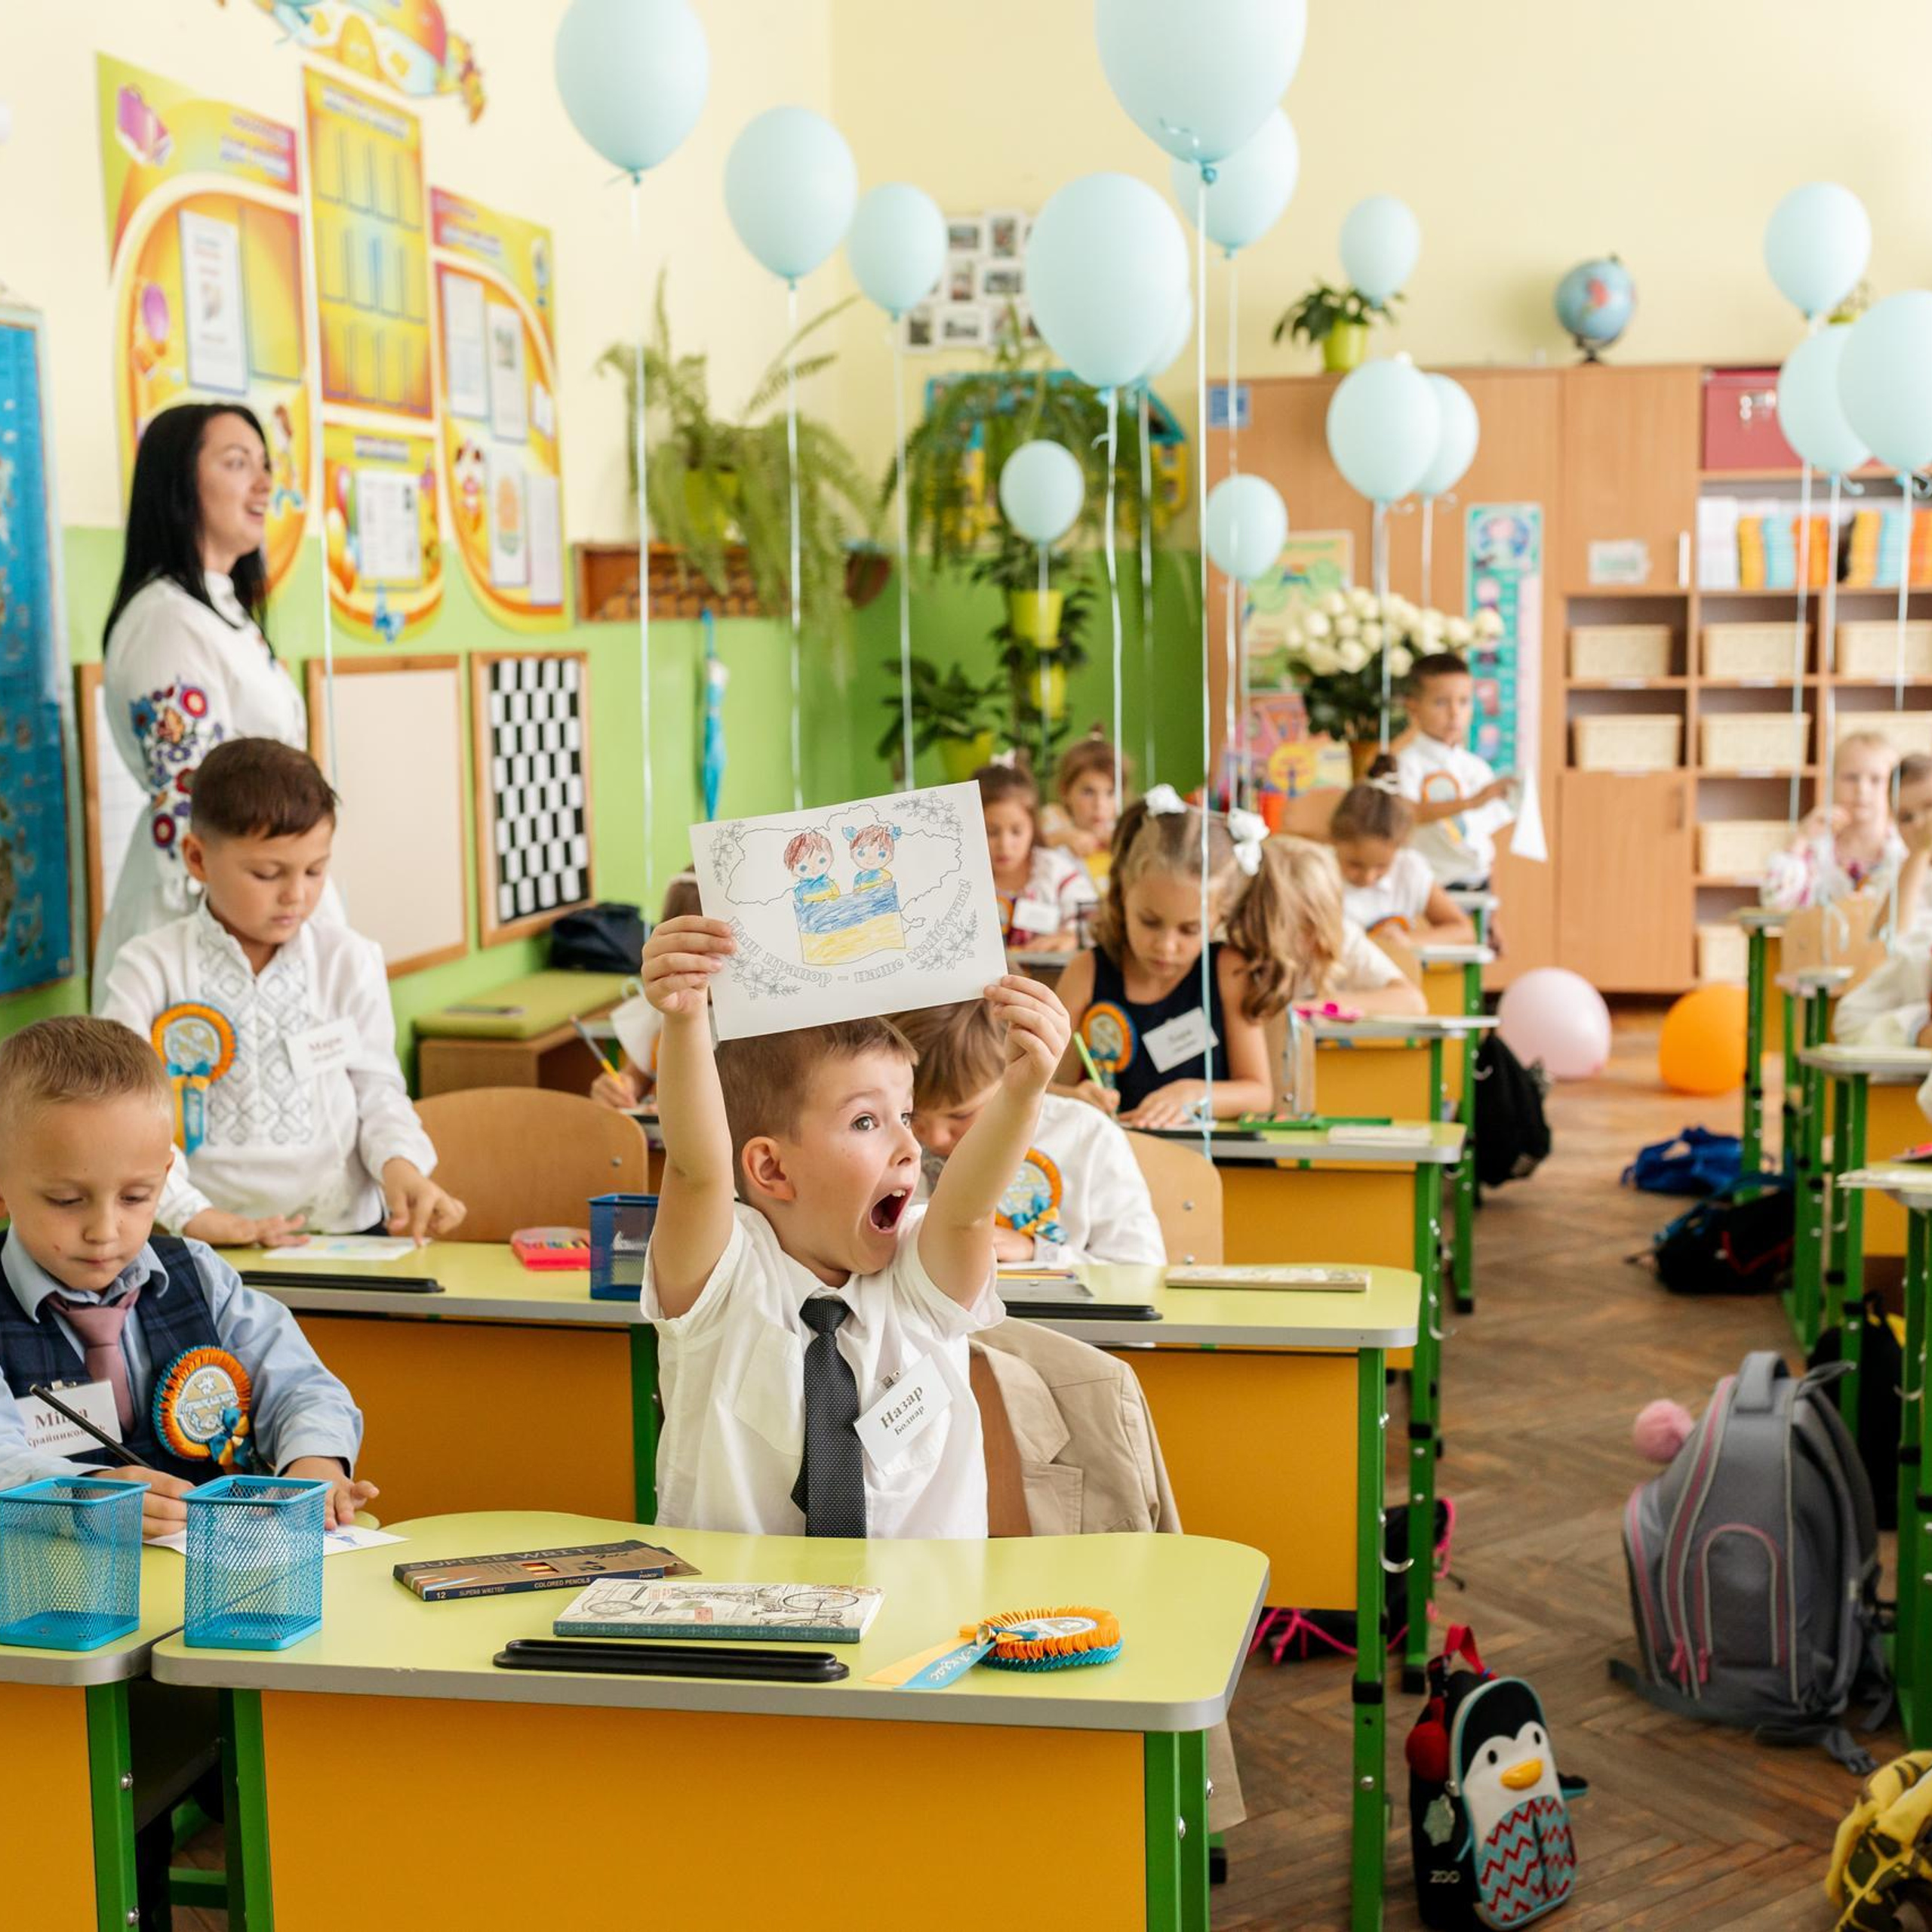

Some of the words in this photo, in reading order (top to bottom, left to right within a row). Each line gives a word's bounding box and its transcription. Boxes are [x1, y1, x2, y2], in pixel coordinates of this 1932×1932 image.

[763, 952, 832, 988] прапор
[34, 1407, 89, 1429] Міа
[880, 1386, 923, 1429] Назар
[409, 1555, 506, 1571] SUPERB
[436, 1590, 447, 1599] 12
[458, 1589, 481, 1598] SUPERB
[481, 1586, 506, 1595] WRITER
[534, 1579, 564, 1589] COLORED
[565, 1576, 591, 1585] PENCILS
